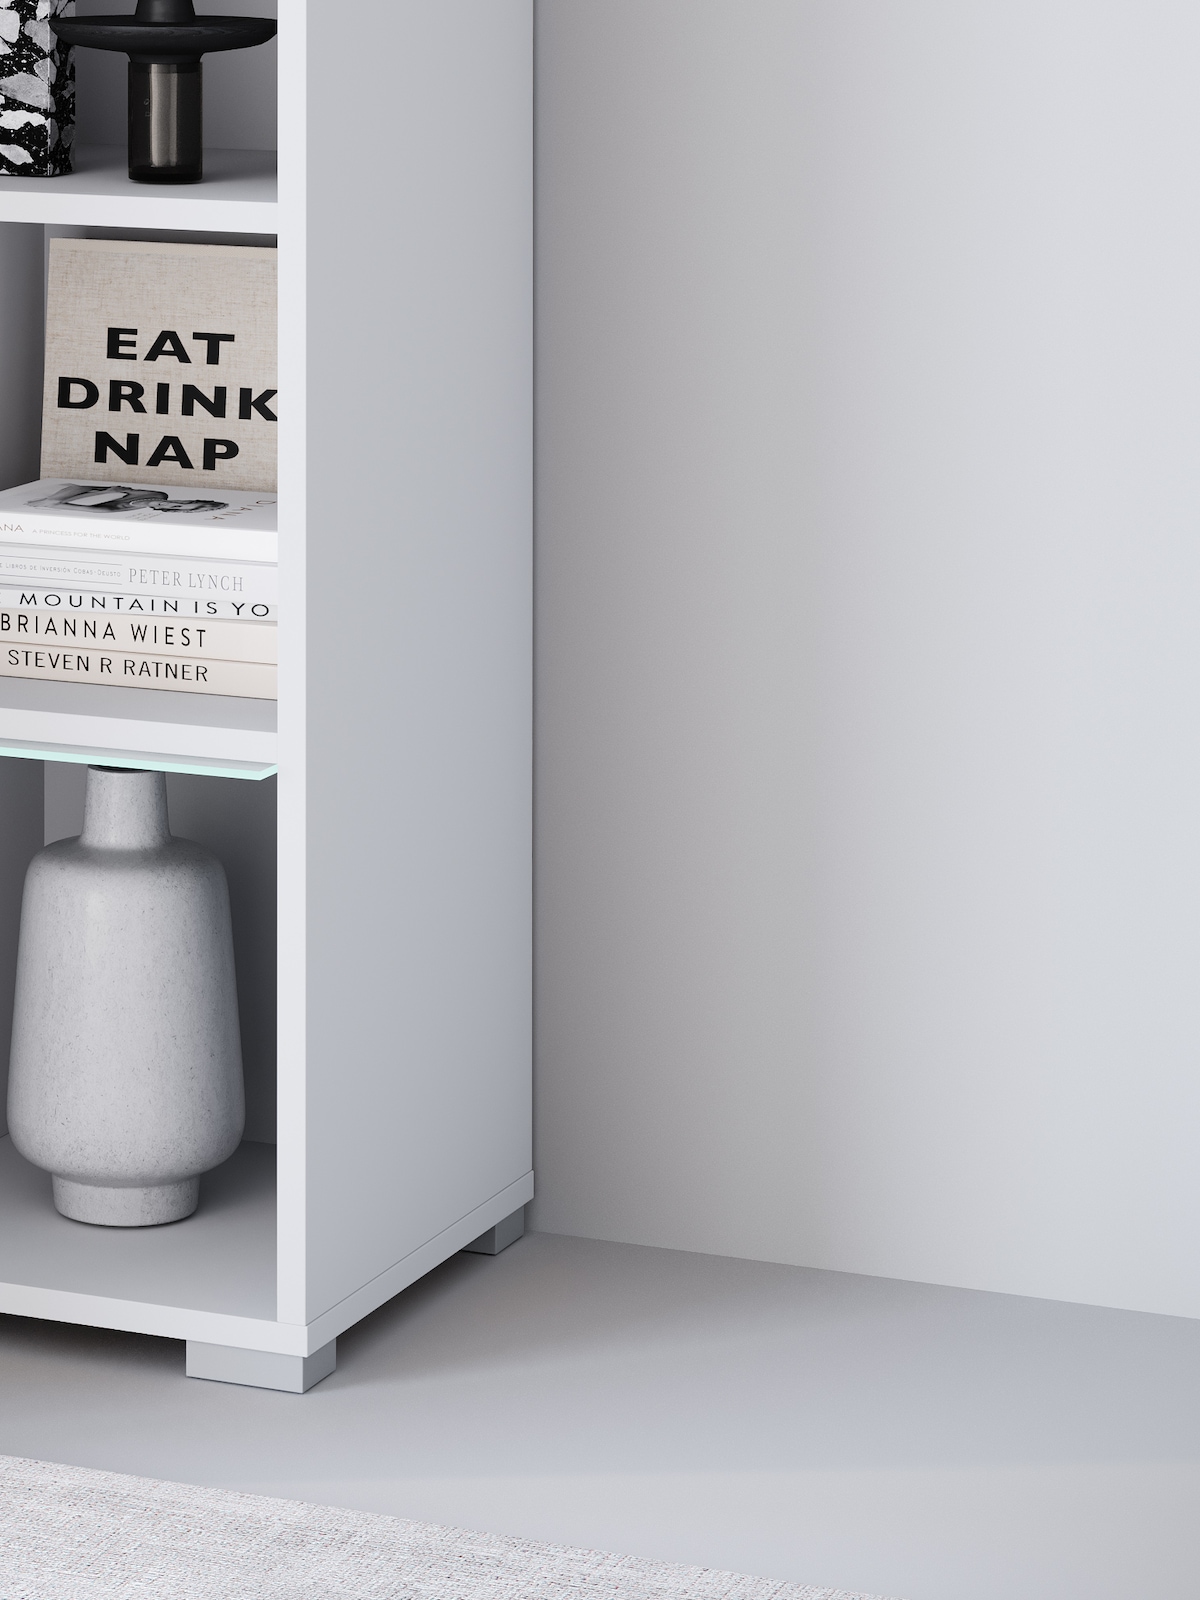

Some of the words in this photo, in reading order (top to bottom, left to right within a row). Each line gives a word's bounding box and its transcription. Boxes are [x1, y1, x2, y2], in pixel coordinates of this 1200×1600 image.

[106, 327, 235, 365] EAT
[57, 376, 277, 421] DRINK
[94, 430, 240, 471] NAP
[39, 528, 72, 537] PRINCESS
[103, 533, 131, 541] WORLD
[129, 568, 182, 587] PETER
[188, 572, 244, 592] LYNCH
[19, 593, 178, 613] MOUNTAIN
[195, 601, 218, 615] IS
[0, 613, 116, 641] BRIANNA
[130, 623, 206, 648] WIEST
[8, 649, 90, 672] STEVEN
[100, 657, 112, 674] R
[123, 659, 209, 683] RATNER
